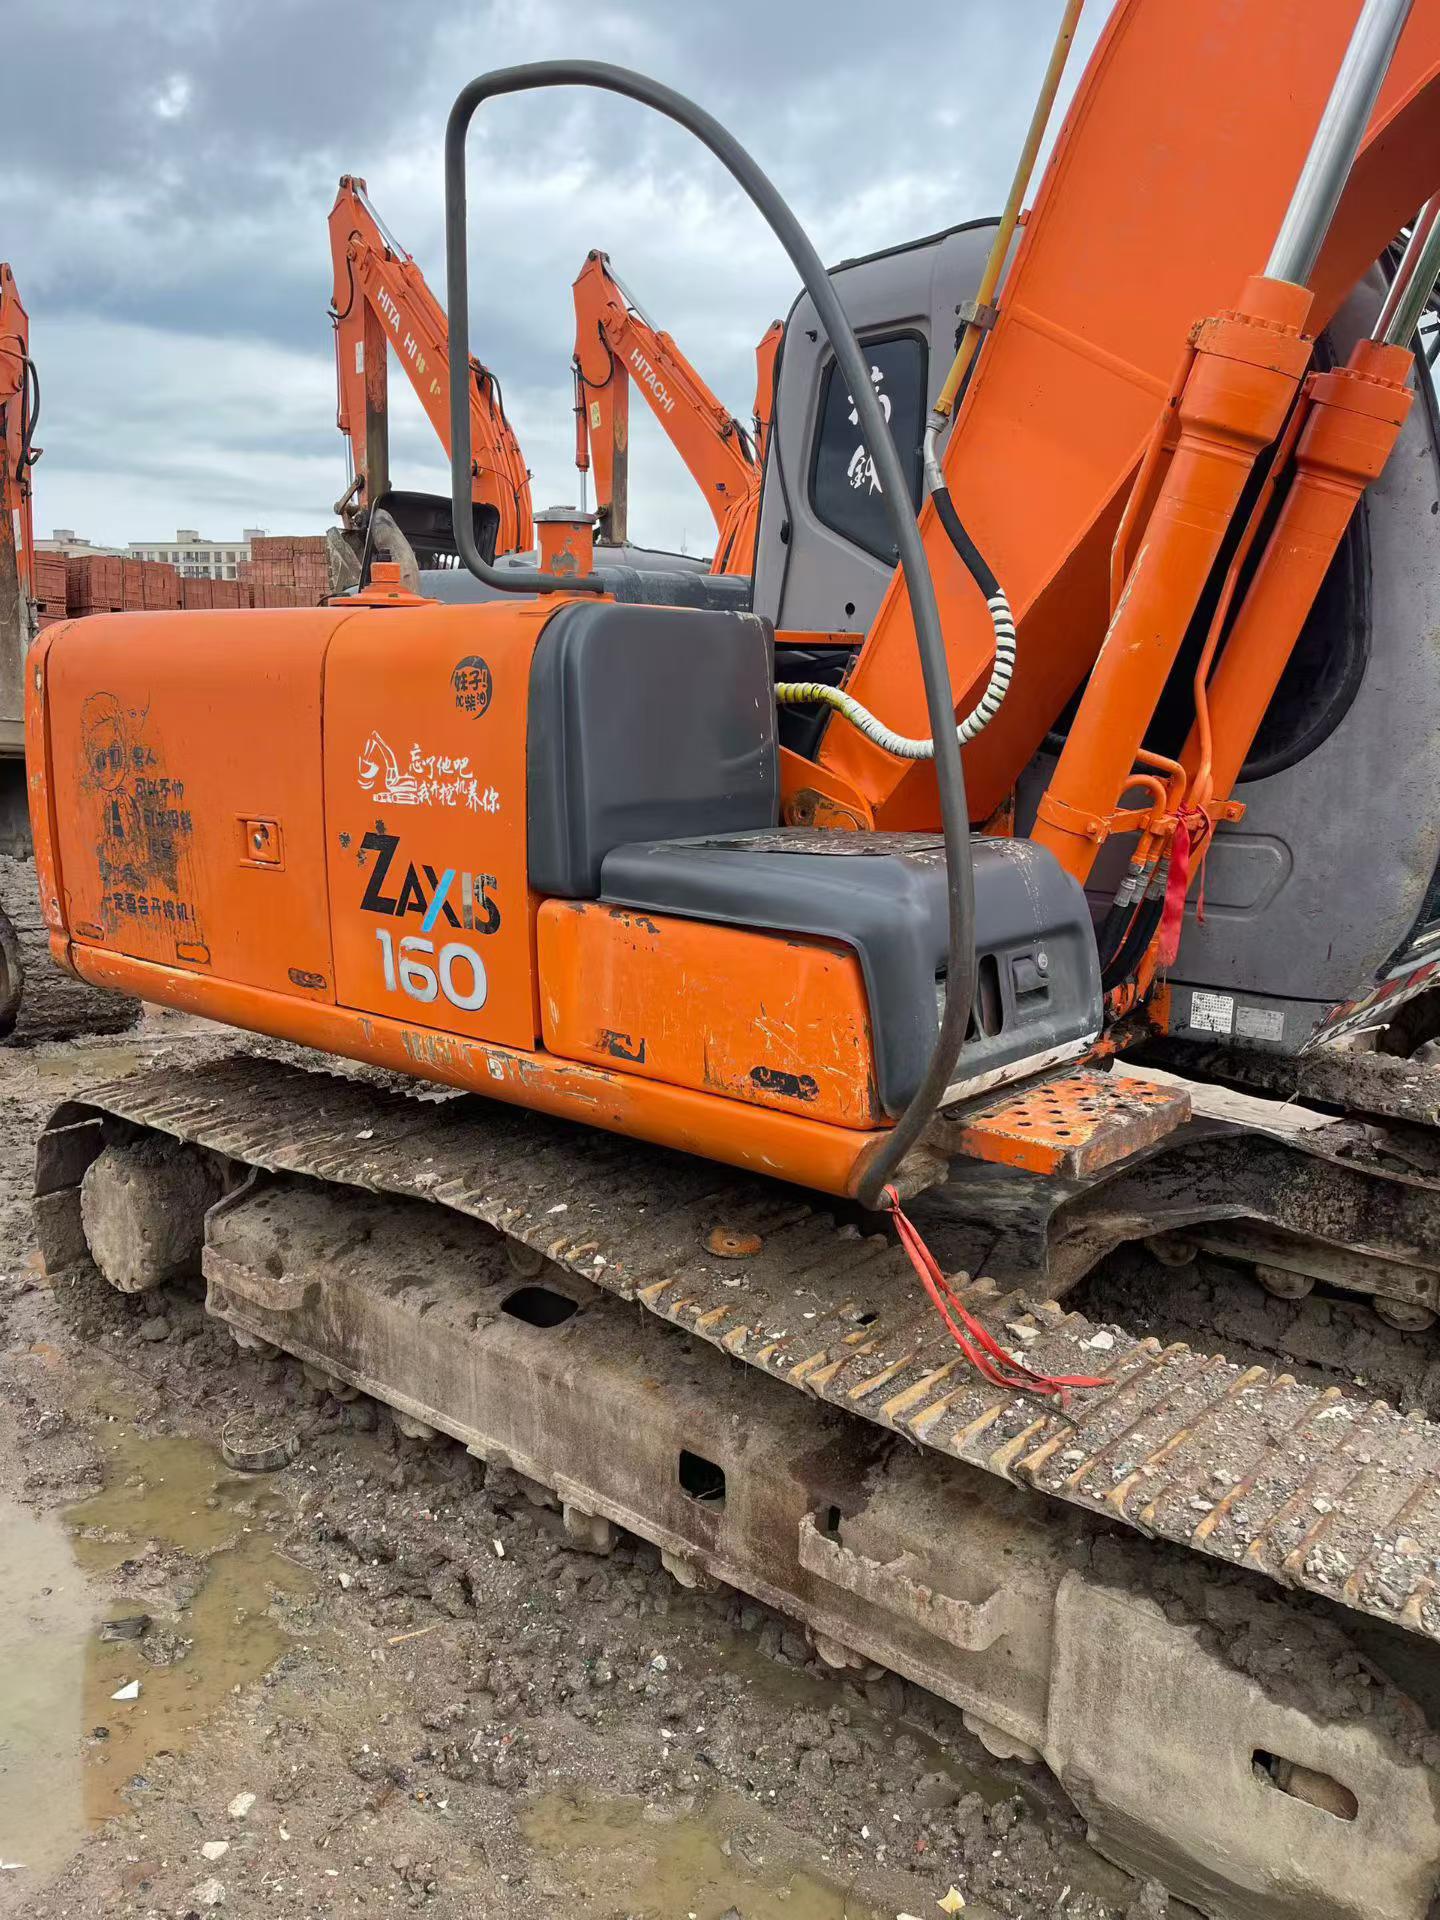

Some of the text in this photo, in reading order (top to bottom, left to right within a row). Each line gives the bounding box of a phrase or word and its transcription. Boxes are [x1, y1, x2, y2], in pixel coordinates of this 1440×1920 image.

[630, 347, 676, 413] HITACHI
[409, 743, 473, 779] 忘了他吧
[419, 778, 501, 814] 我开挖机养你
[360, 831, 501, 935] ZAXIS
[375, 927, 488, 1012] 160
